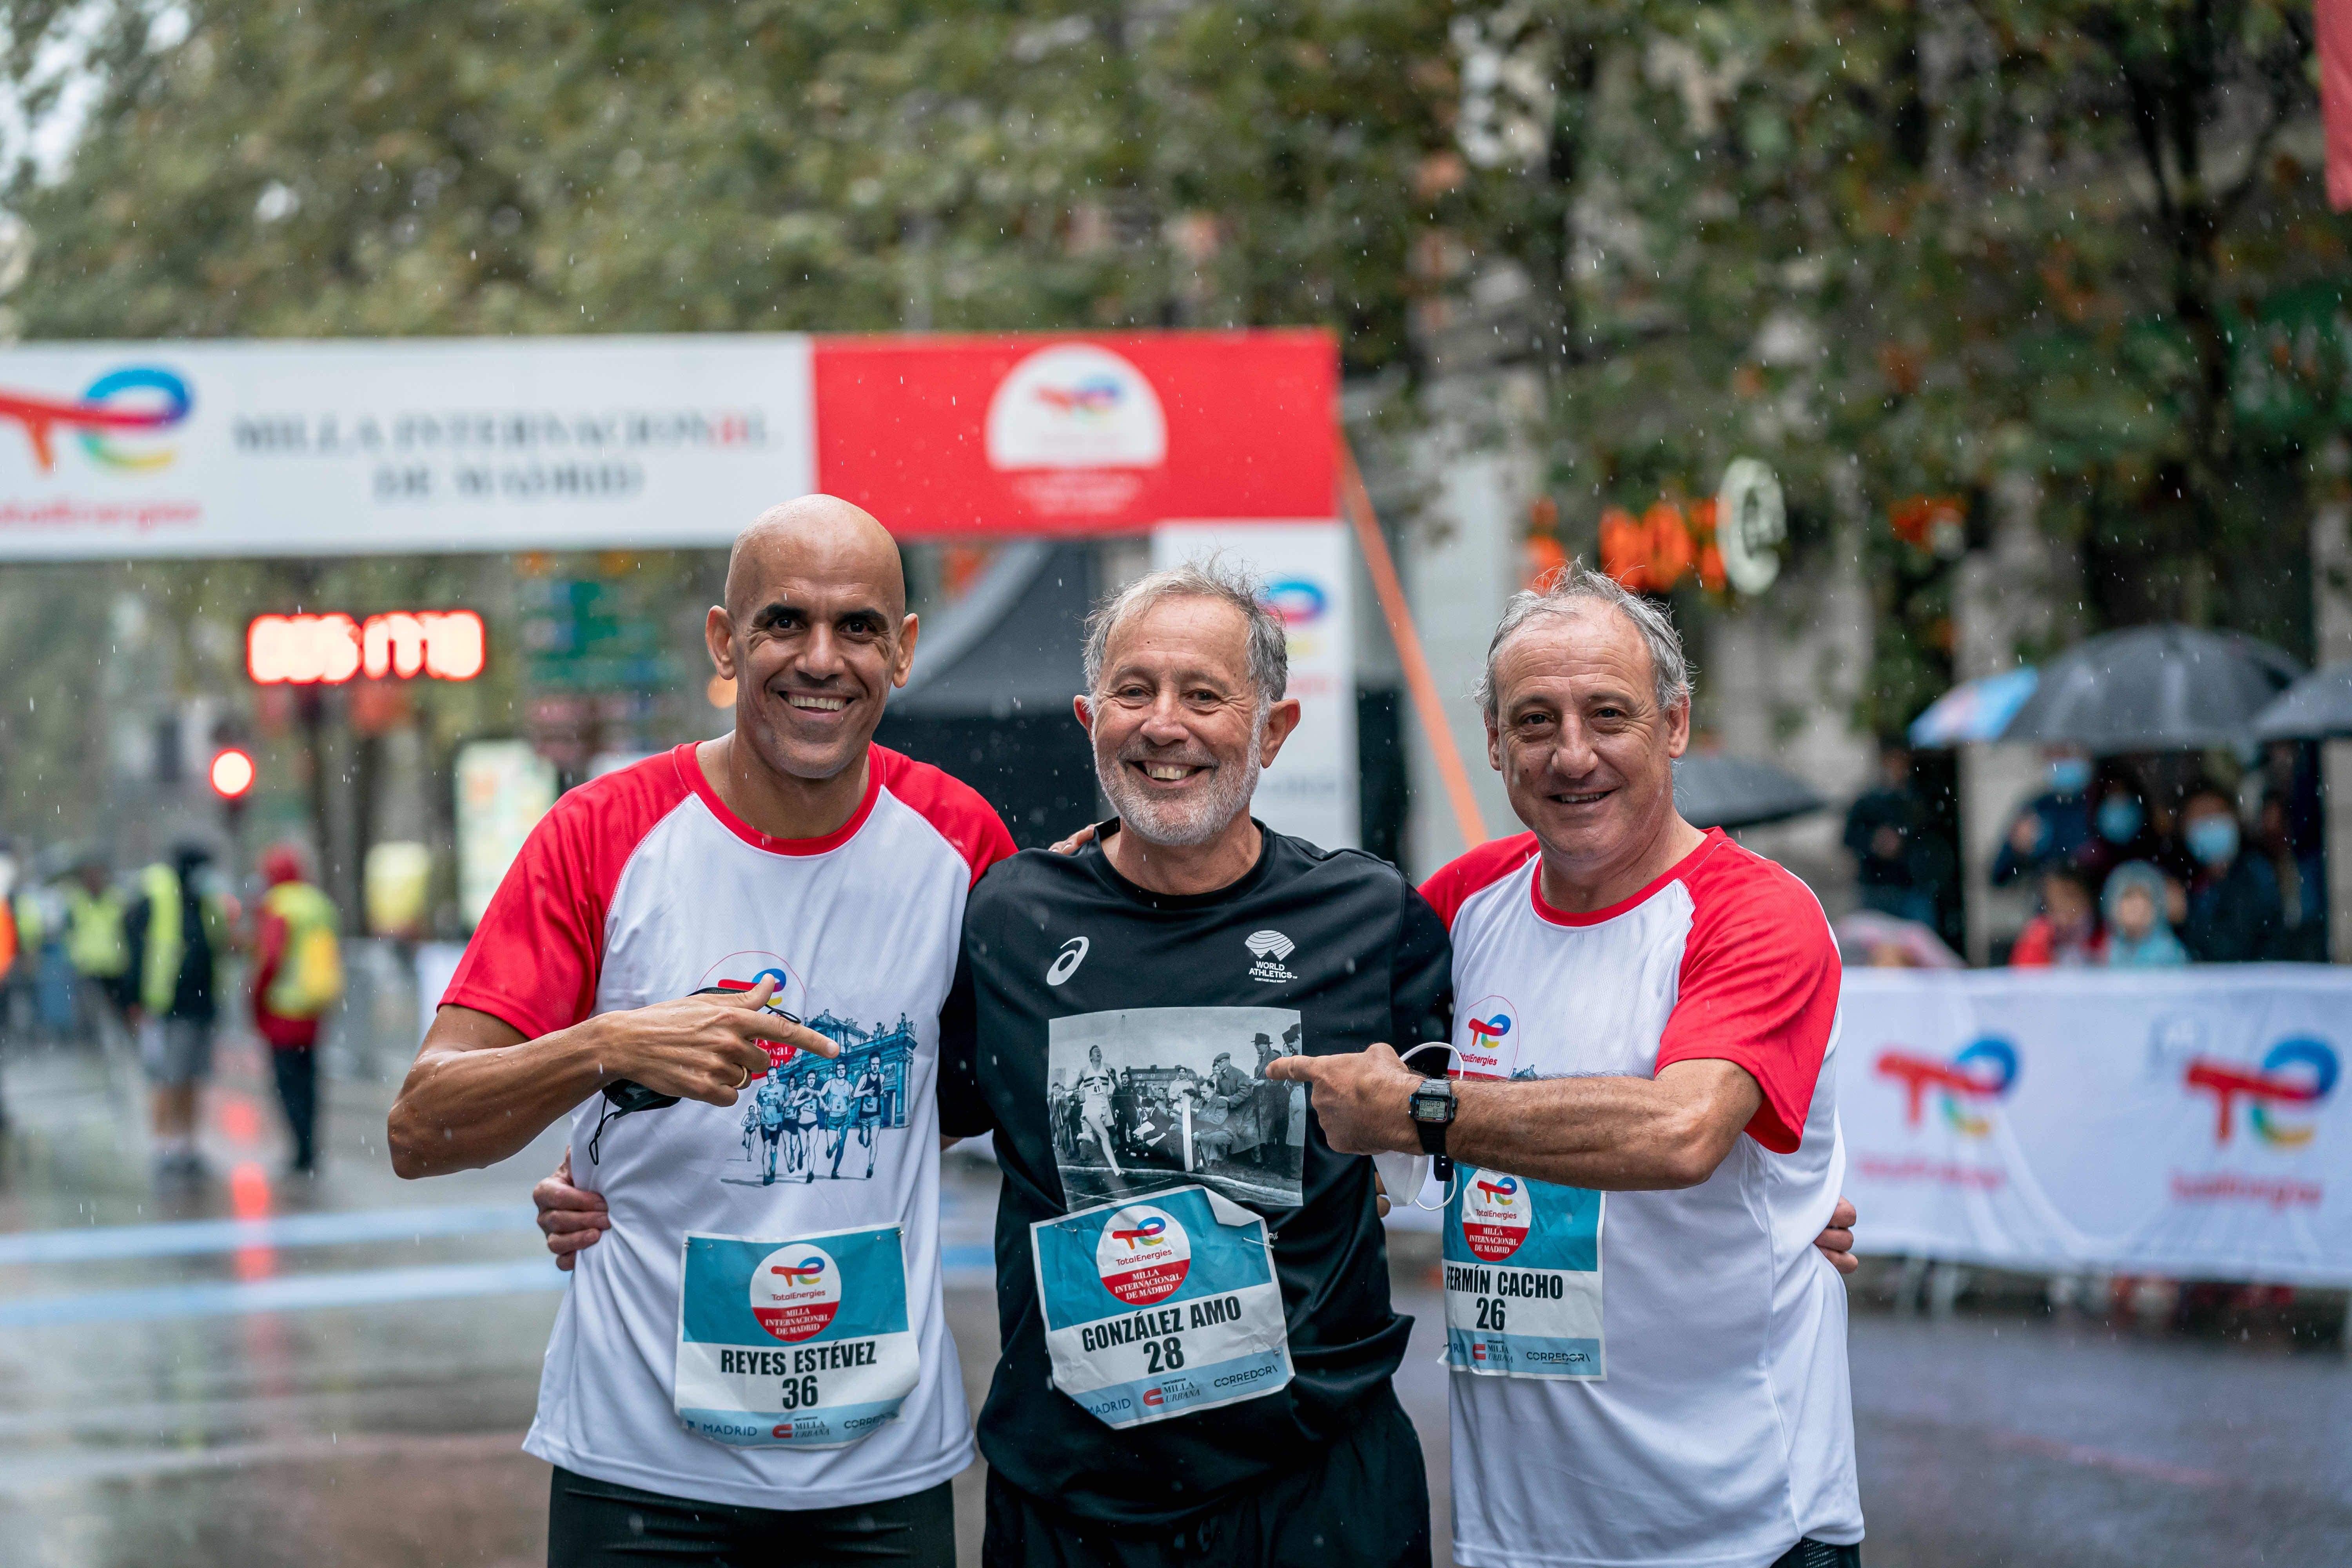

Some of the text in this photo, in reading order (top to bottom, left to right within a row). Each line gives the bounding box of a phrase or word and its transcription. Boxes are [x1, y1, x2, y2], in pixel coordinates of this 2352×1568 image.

[1256, 961, 1285, 971] WORLD
[1249, 968, 1292, 978] ATHLETICS
[1094, 1085, 1100, 1093] 41
[1475, 1209, 1517, 1220] TotalEnergies
[1483, 1227, 1503, 1236] MILLA
[1484, 1245, 1510, 1254] MADRID
[1116, 1249, 1172, 1266] TotalEnergies
[1132, 1269, 1160, 1281] MILLA
[1446, 1265, 1563, 1299] FERMÍN CACHO
[771, 1289, 826, 1301] TotalEnergies
[1125, 1283, 1173, 1301] DE MADRID
[786, 1307, 810, 1318] MILLA
[1476, 1297, 1506, 1331] 26
[790, 1323, 820, 1334] MADRID
[1082, 1296, 1242, 1352] GONZÁLEZ AMO
[721, 1341, 877, 1376] REYES ESTÉVEZ
[1143, 1336, 1185, 1374] 28
[782, 1375, 819, 1410] 36
[1163, 1381, 1195, 1393] MILLA
[1166, 1388, 1201, 1403] URBANA
[703, 1423, 758, 1437] MADRID
[795, 1420, 825, 1430] MILLA
